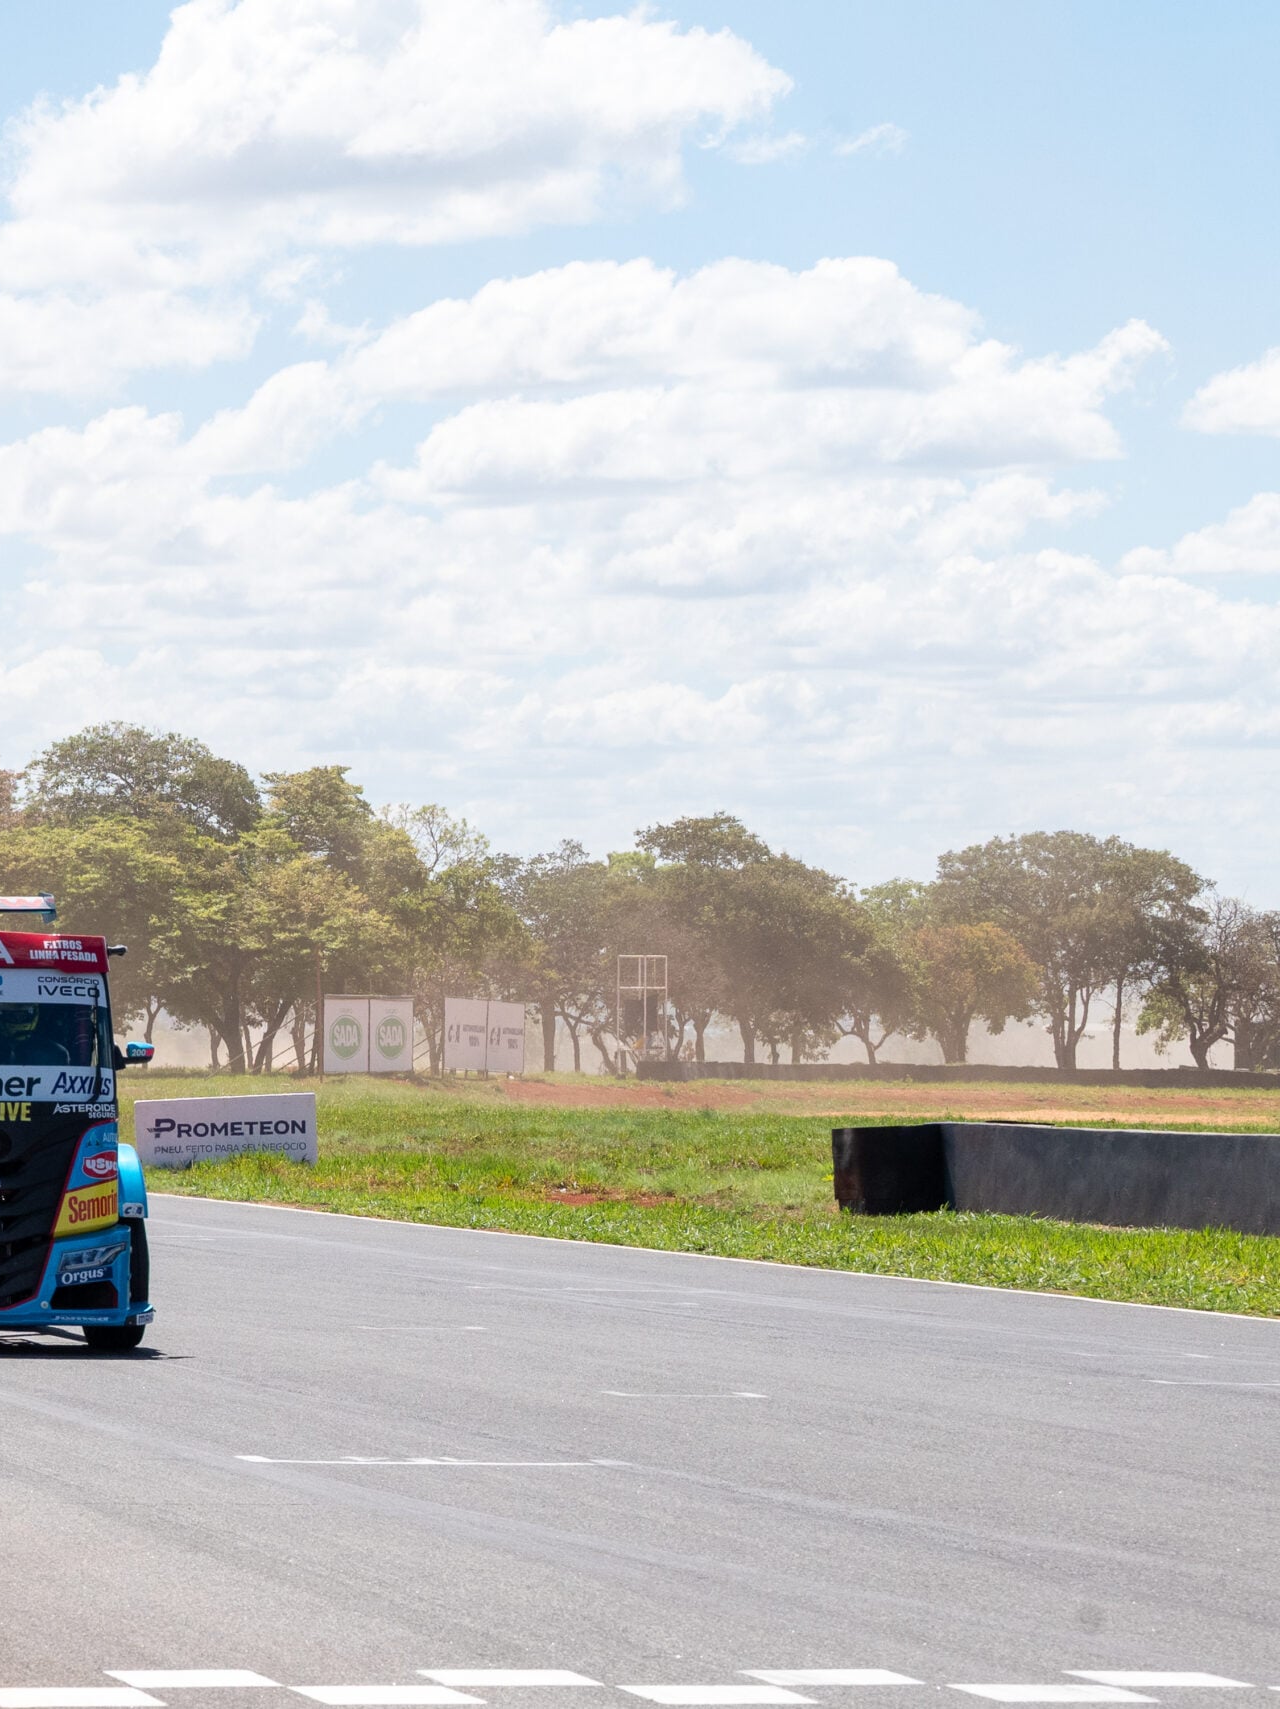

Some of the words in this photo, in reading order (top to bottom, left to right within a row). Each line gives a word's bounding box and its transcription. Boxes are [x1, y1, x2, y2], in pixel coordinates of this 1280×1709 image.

[43, 940, 82, 950] FILTROS
[29, 950, 59, 960] LINHA
[60, 950, 97, 963] PESADA
[37, 975, 100, 985] CONSÓRCIO
[38, 985, 100, 998] IVECO
[333, 1025, 359, 1046] SADA
[379, 1025, 403, 1047] SADA
[50, 1071, 111, 1097] AXXIS
[53, 1103, 116, 1114] ASTEROIDE
[145, 1118, 306, 1139] PROMETEON
[154, 1145, 183, 1154] PNEU.
[186, 1144, 212, 1153] FEITO
[215, 1144, 240, 1152] PARA
[61, 1268, 104, 1285] Orgus
